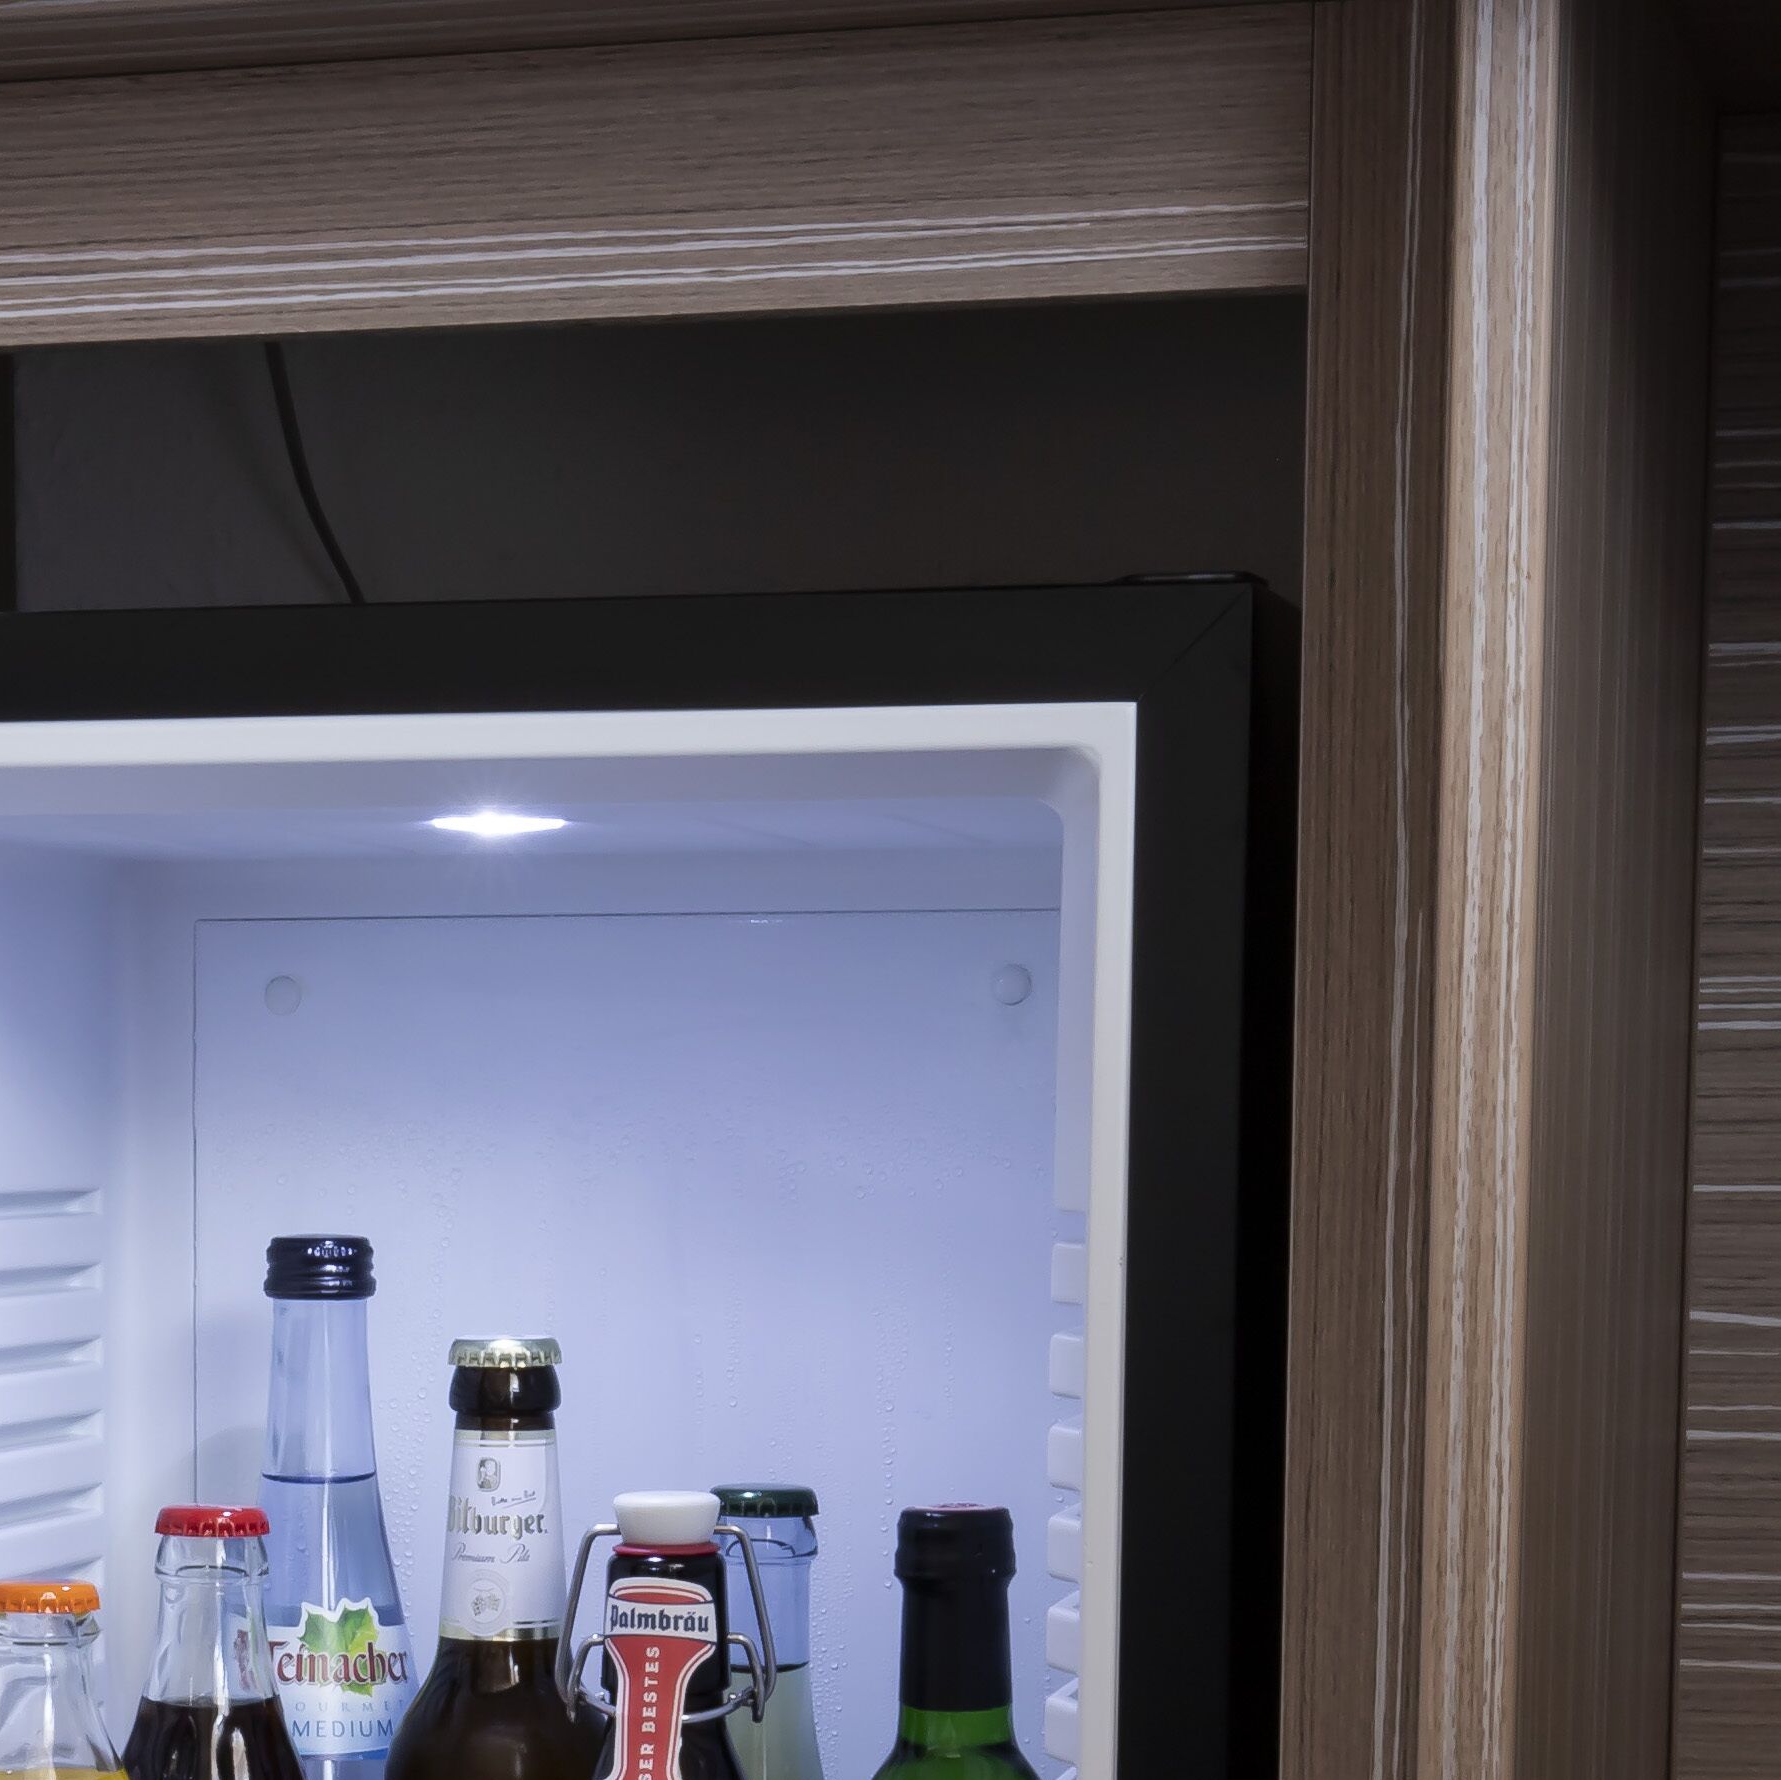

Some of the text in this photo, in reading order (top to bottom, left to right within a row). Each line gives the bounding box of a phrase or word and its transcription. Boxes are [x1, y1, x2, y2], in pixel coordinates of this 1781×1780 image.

[610, 1604, 710, 1633] Palmbräu
[641, 1645, 662, 1734] BESTES
[291, 1719, 394, 1737] MEDIUM
